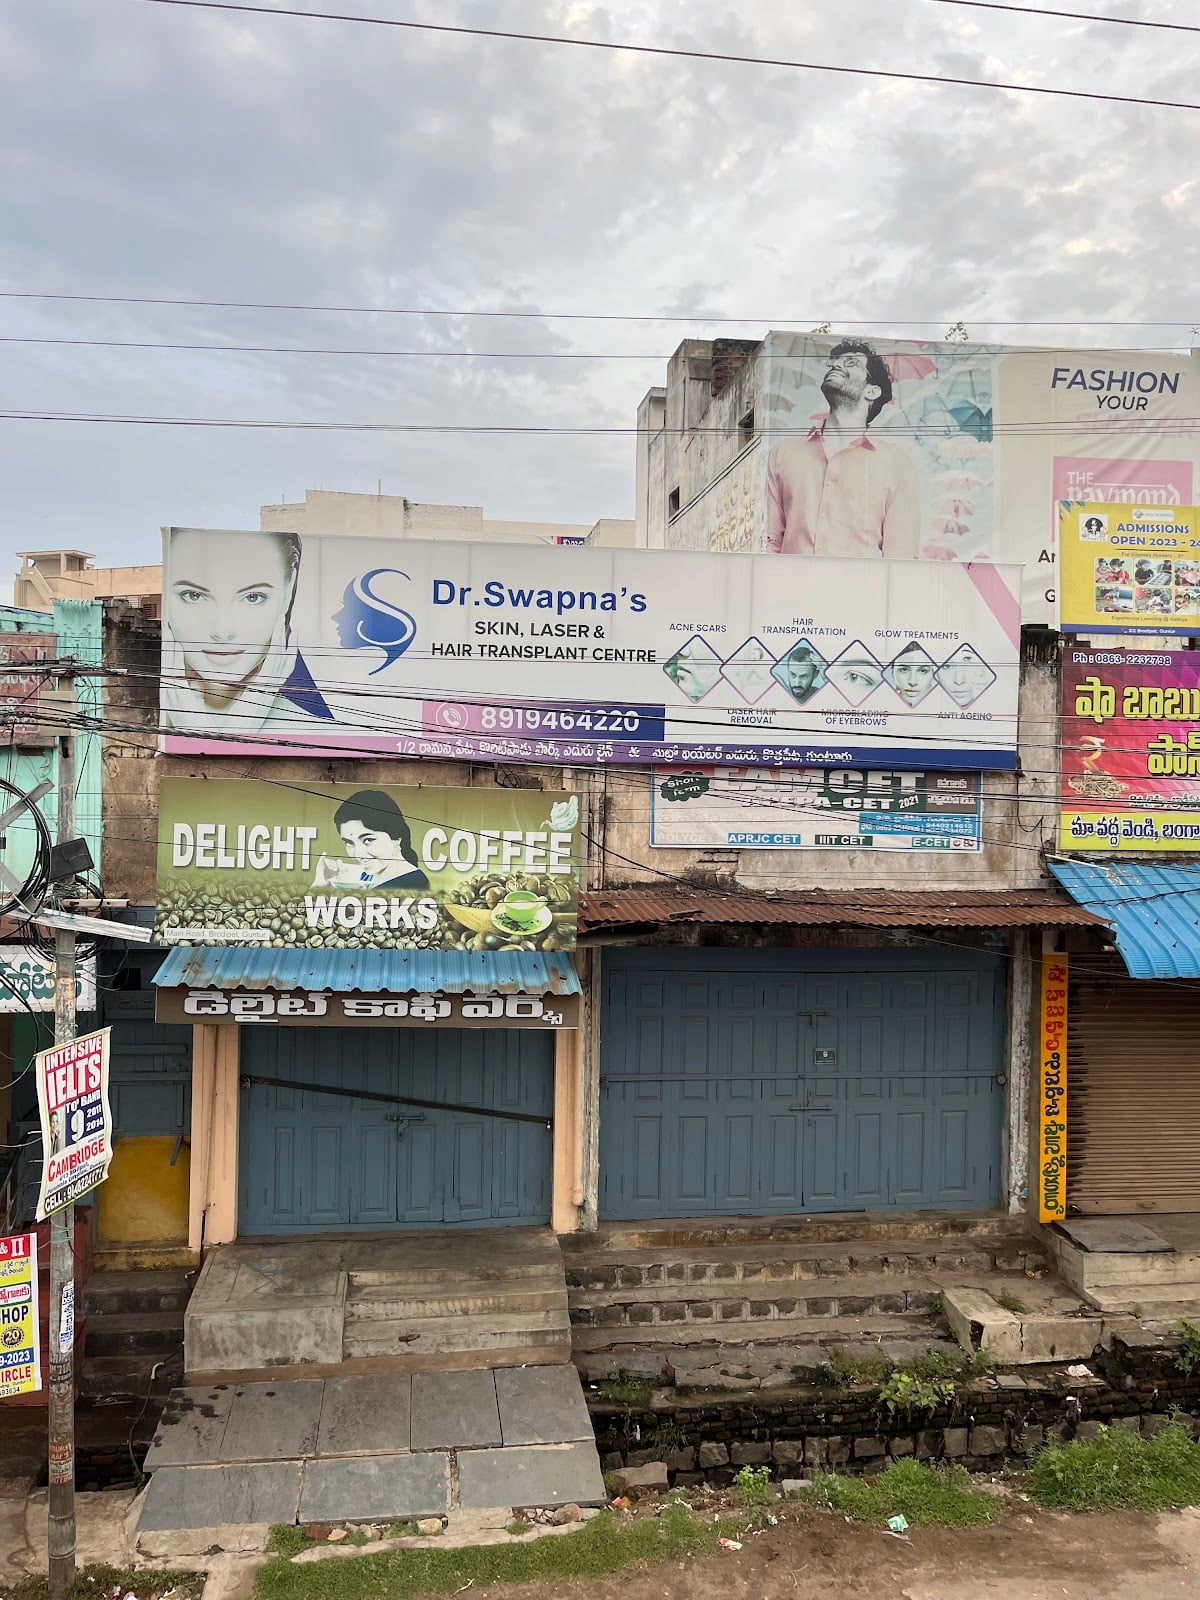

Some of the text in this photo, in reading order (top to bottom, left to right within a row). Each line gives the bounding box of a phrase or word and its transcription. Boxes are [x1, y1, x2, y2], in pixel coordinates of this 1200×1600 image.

[1051, 367, 1180, 394] FASHION
[1096, 395, 1148, 411] YOUR
[1067, 471, 1094, 485] THE
[1117, 523, 1189, 534] ADMISSIONS
[1110, 535, 1146, 546] OPEN
[1149, 538, 1177, 546] 2023
[475, 620, 606, 639] SKIN, LASER &
[669, 623, 727, 633] ACNE SCARS
[792, 618, 814, 626] HAIR
[762, 625, 846, 636] TRANSPLANTATION
[874, 629, 959, 640] GLOW TREATMENTS
[432, 641, 656, 663] HAIR TRANSPLANT CENTRE
[1073, 653, 1088, 664] Ph
[1127, 655, 1171, 666] 2232798
[481, 706, 640, 732] 8919464220
[730, 716, 774, 725] REMOVAL
[825, 717, 887, 726] OF EYEBROWS
[899, 795, 920, 808] 2021
[728, 834, 771, 844] APRJC
[774, 835, 799, 844] CET
[841, 836, 866, 845] CET
[913, 838, 950, 847] E-CET
[172, 823, 572, 875] DELIGHT COFFEE
[303, 895, 439, 930] WORKS
[45, 1035, 102, 1069] INTENSIVE
[47, 1052, 102, 1110] IELTS
[80, 1090, 101, 1107] BAND
[70, 1109, 84, 1142] 9
[48, 1138, 105, 1182] CAMBRIDGE
[45, 1192, 63, 1212] CELL
